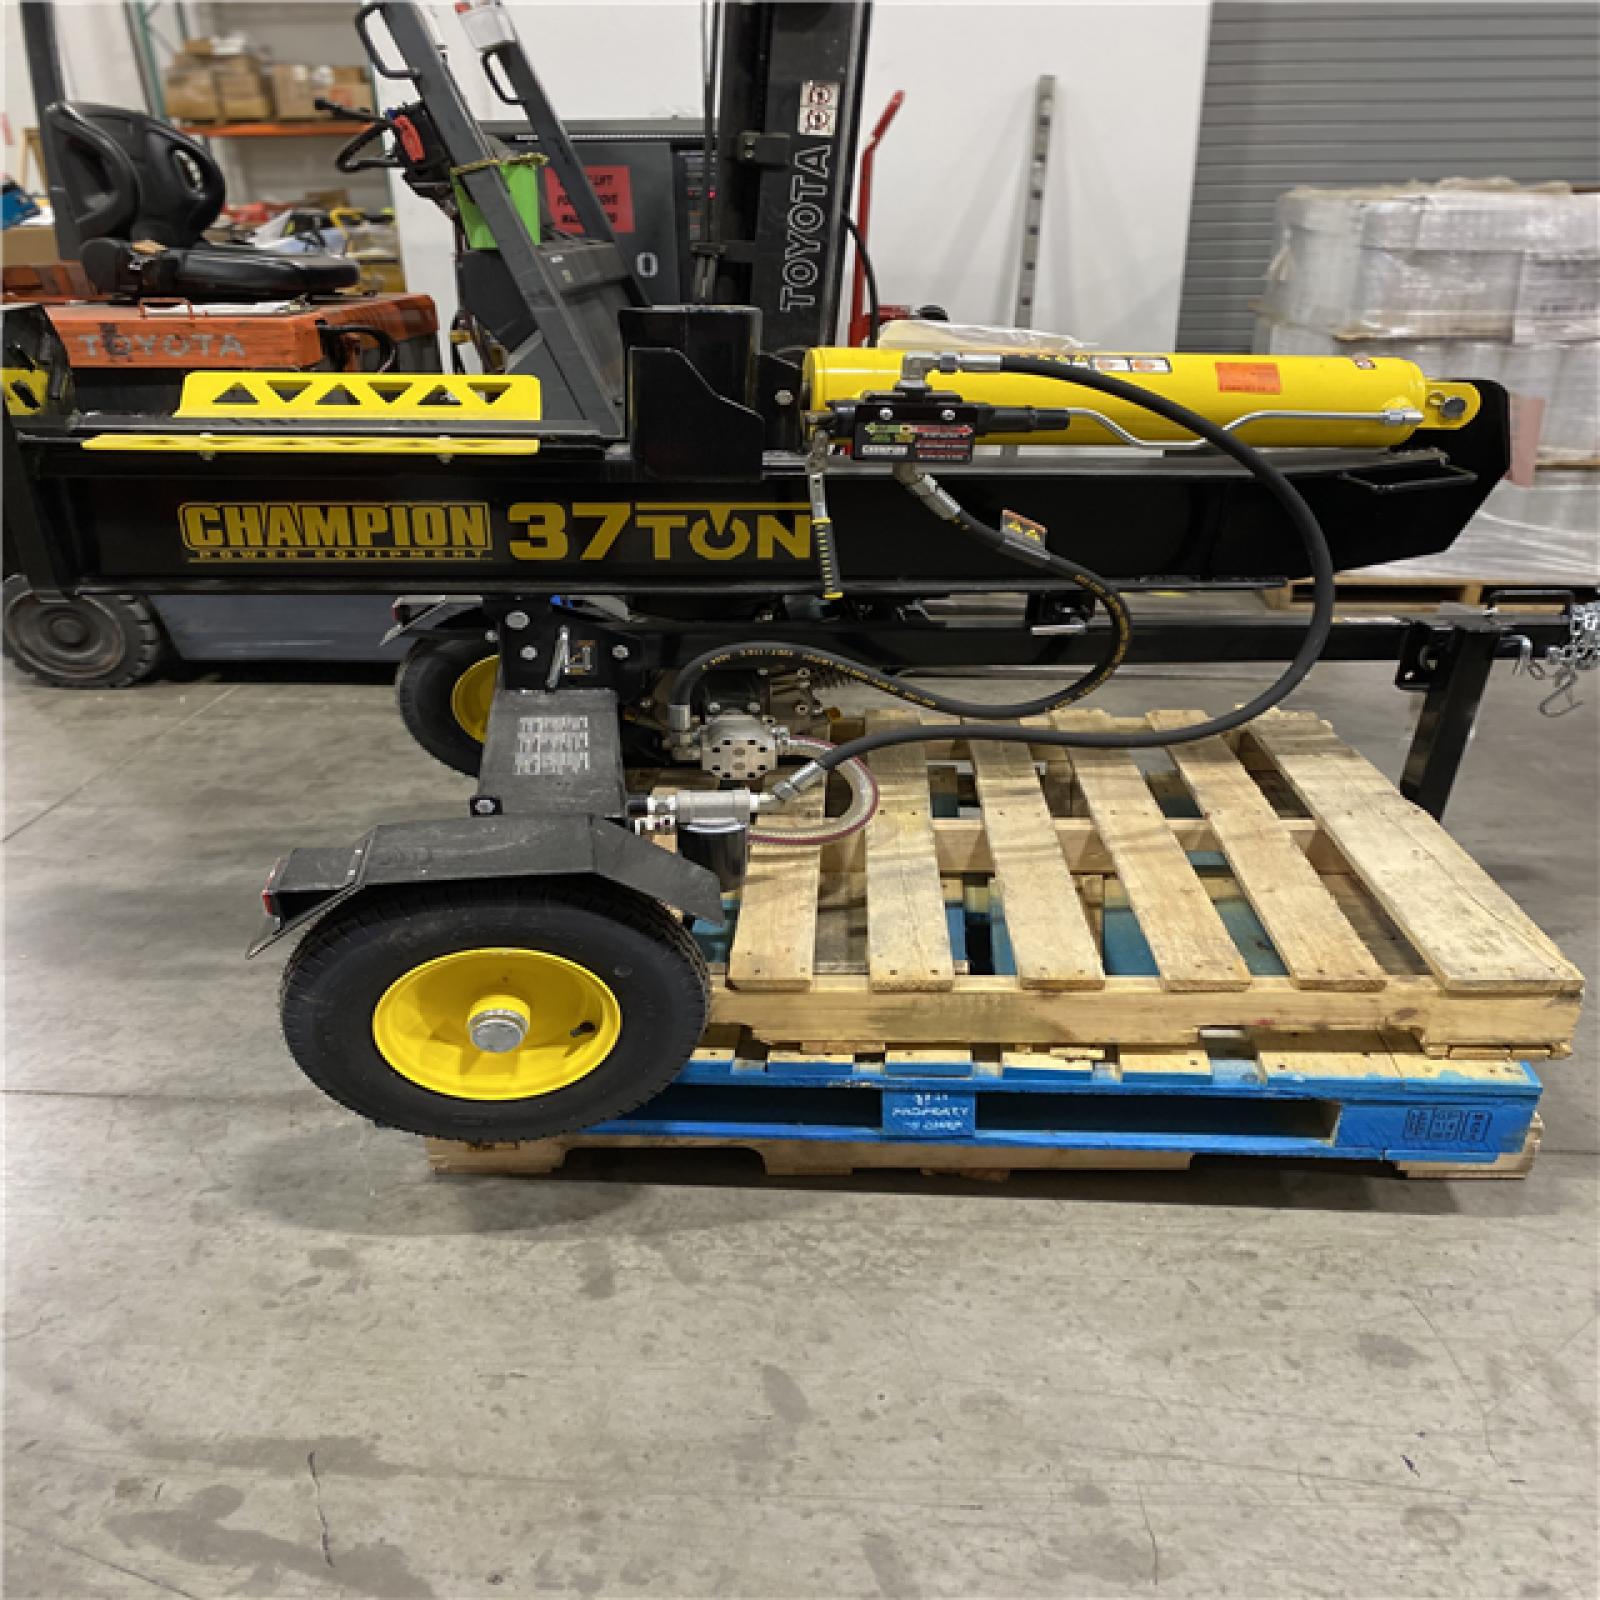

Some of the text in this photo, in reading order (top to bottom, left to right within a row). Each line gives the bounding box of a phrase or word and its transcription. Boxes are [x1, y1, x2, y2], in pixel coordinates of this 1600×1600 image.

[780, 144, 832, 312] TOYOTA
[79, 334, 245, 358] TOYOTA
[183, 504, 488, 547] CHAMPION
